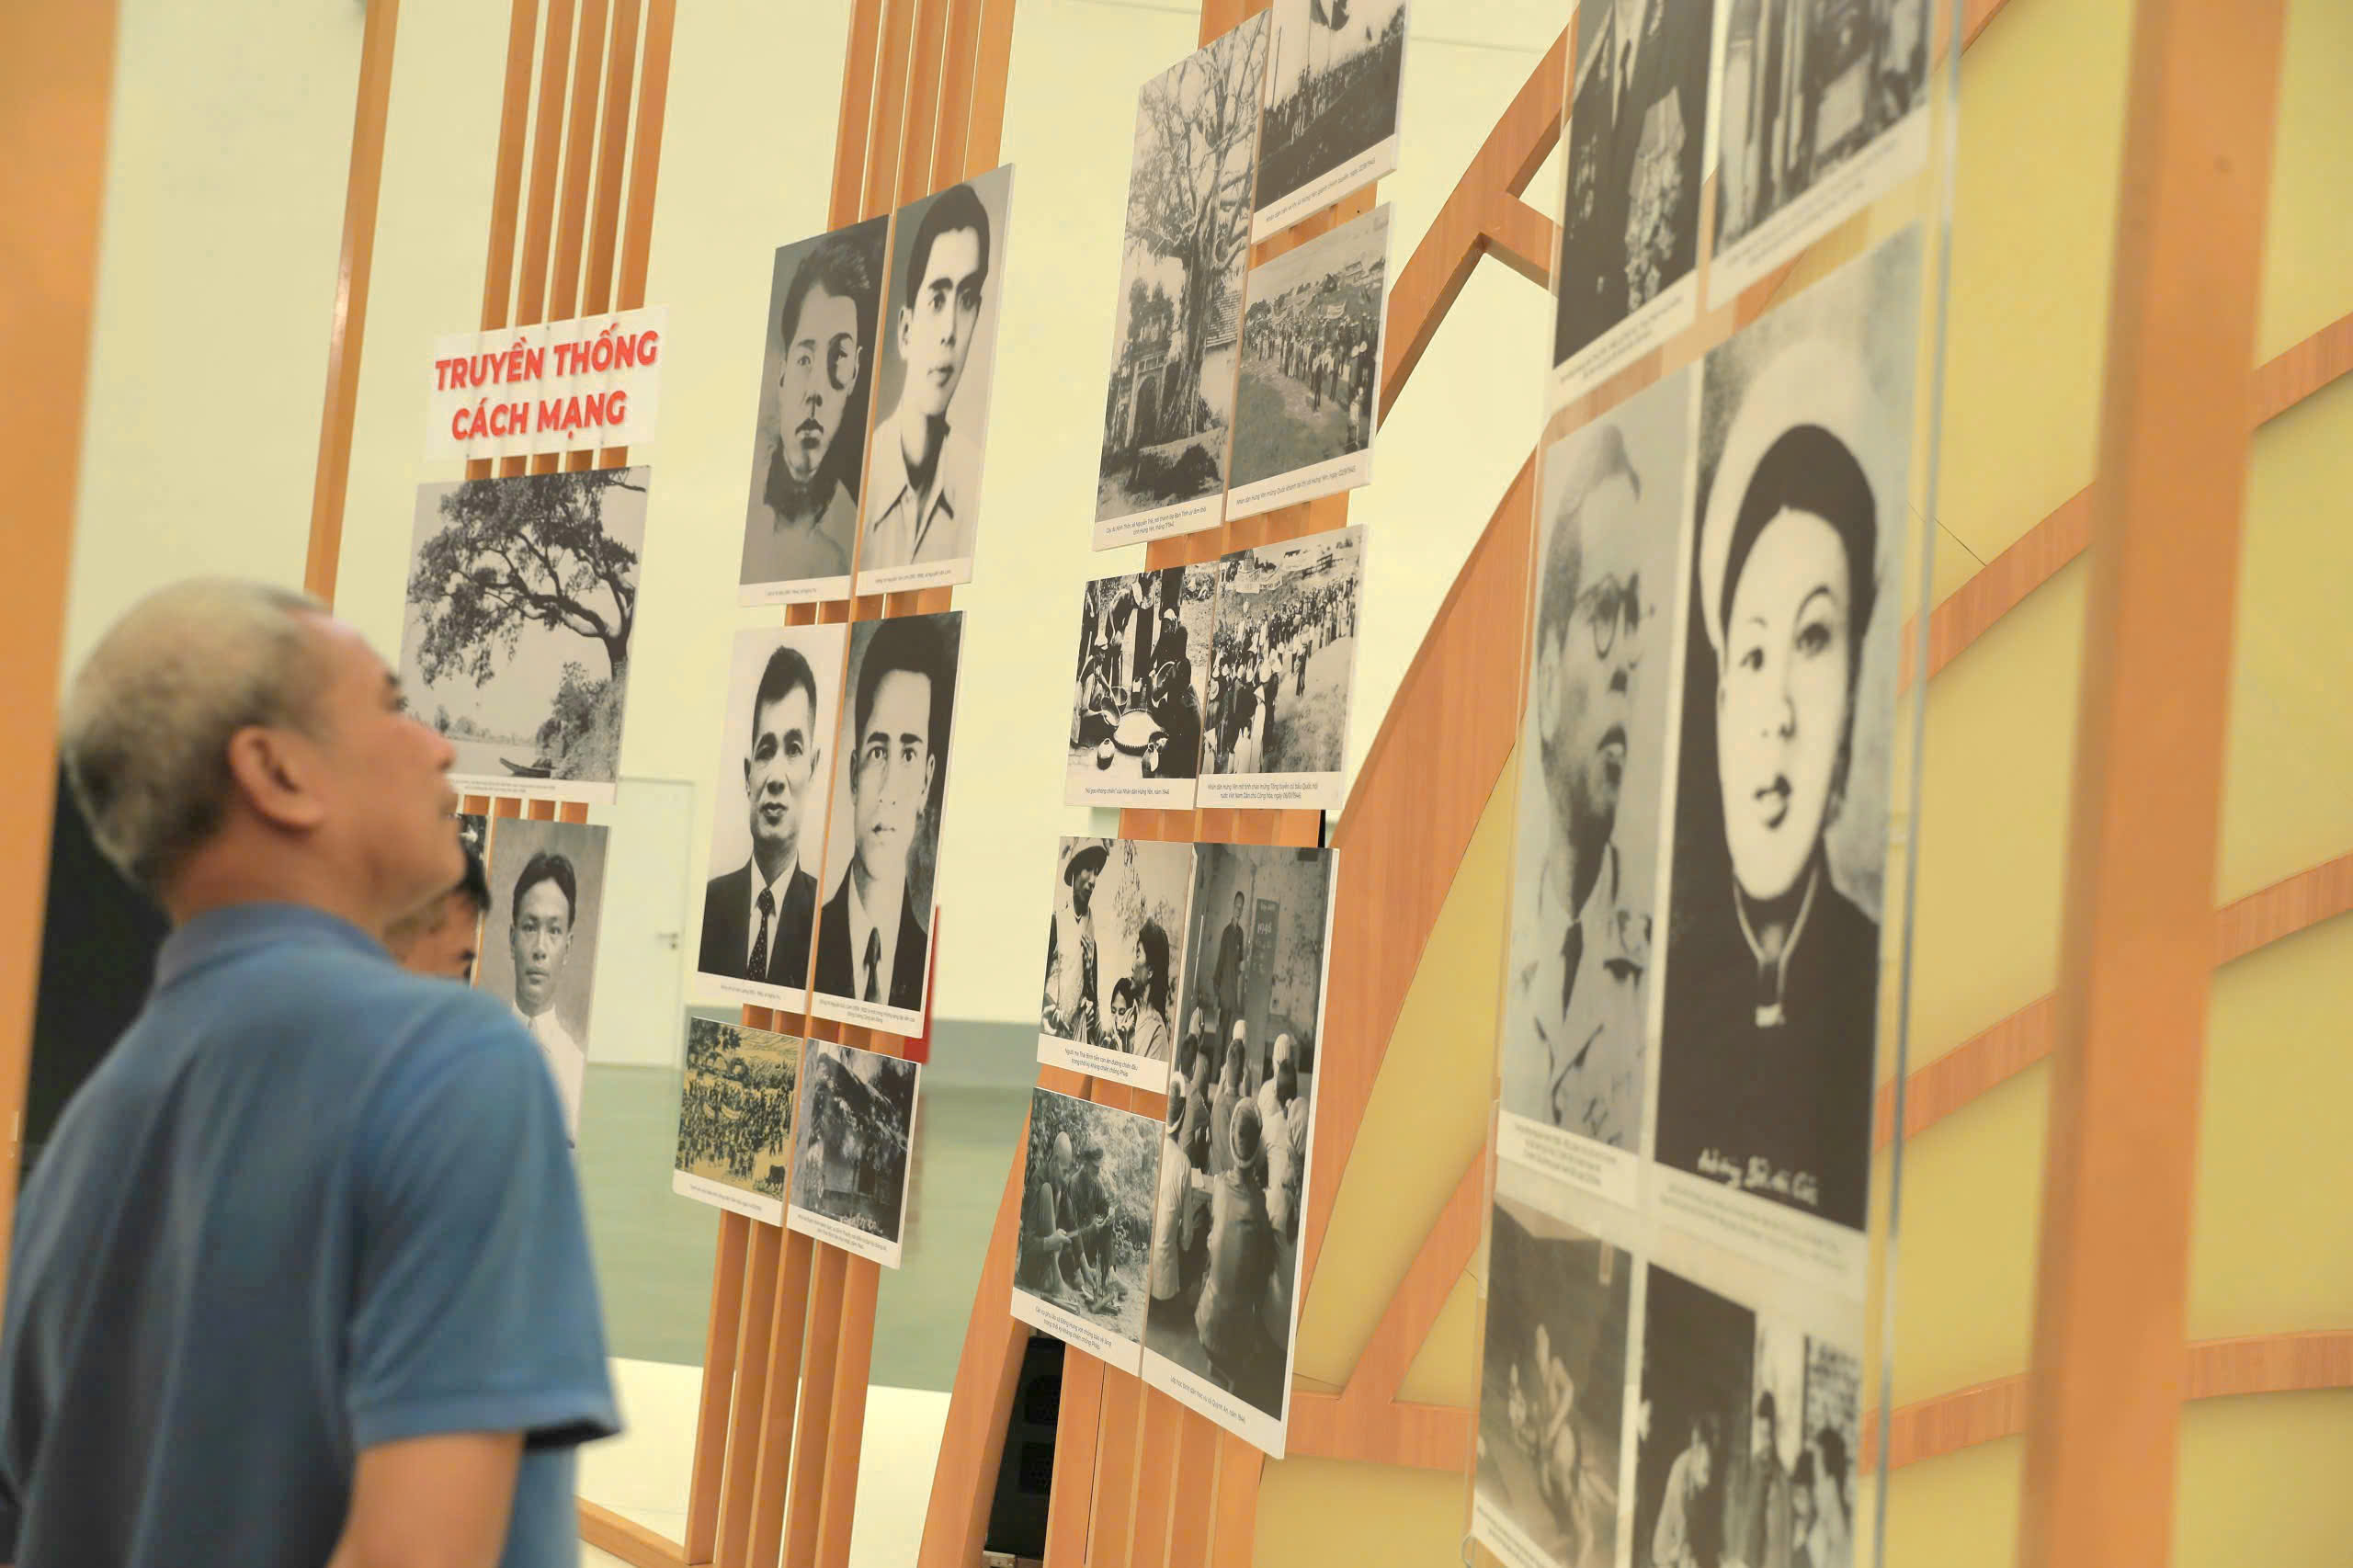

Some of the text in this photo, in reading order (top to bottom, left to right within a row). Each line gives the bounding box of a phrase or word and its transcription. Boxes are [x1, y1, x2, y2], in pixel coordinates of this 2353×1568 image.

[436, 323, 659, 391] TRUYỀN THỐNG
[452, 391, 627, 440] CÁCH MẠNG
